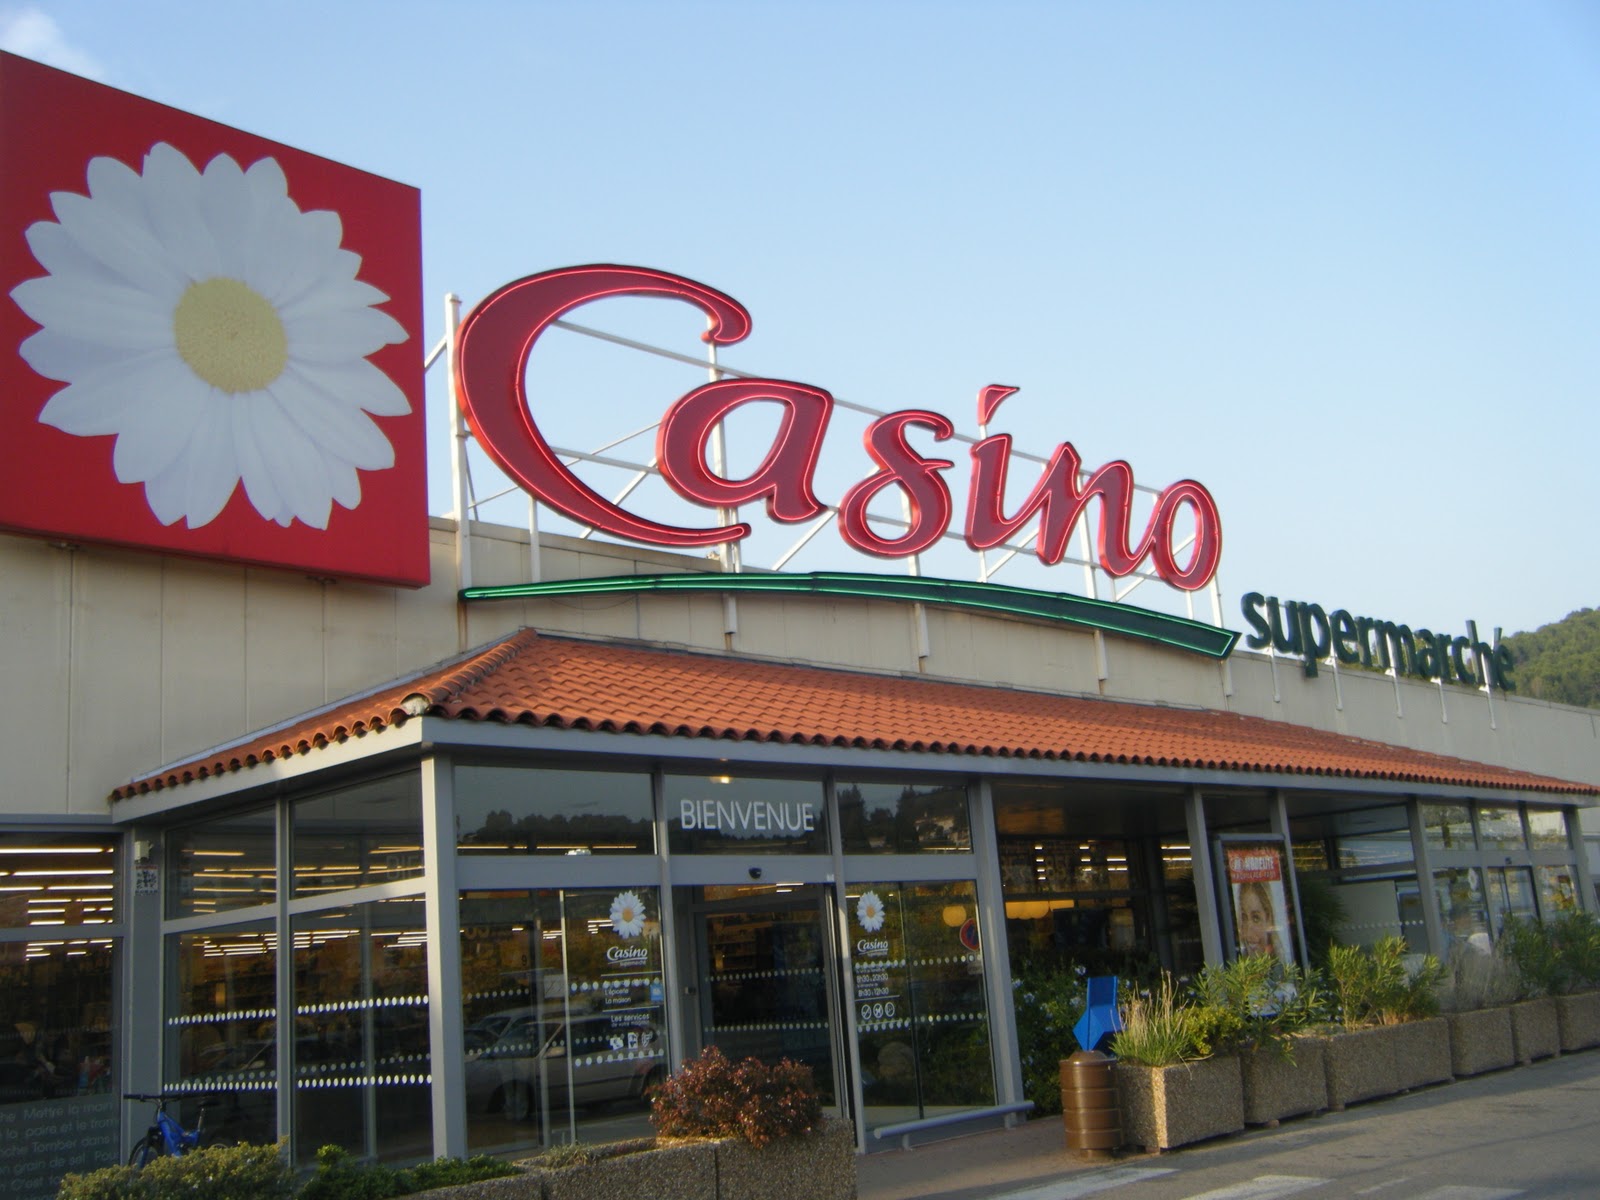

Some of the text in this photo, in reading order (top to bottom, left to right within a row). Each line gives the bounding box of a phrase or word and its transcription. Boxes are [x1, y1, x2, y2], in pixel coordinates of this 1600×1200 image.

[455, 263, 1223, 592] Casino
[680, 799, 815, 831] BIENVENUE
[606, 945, 648, 961] Casino
[857, 938, 888, 953] Casino
